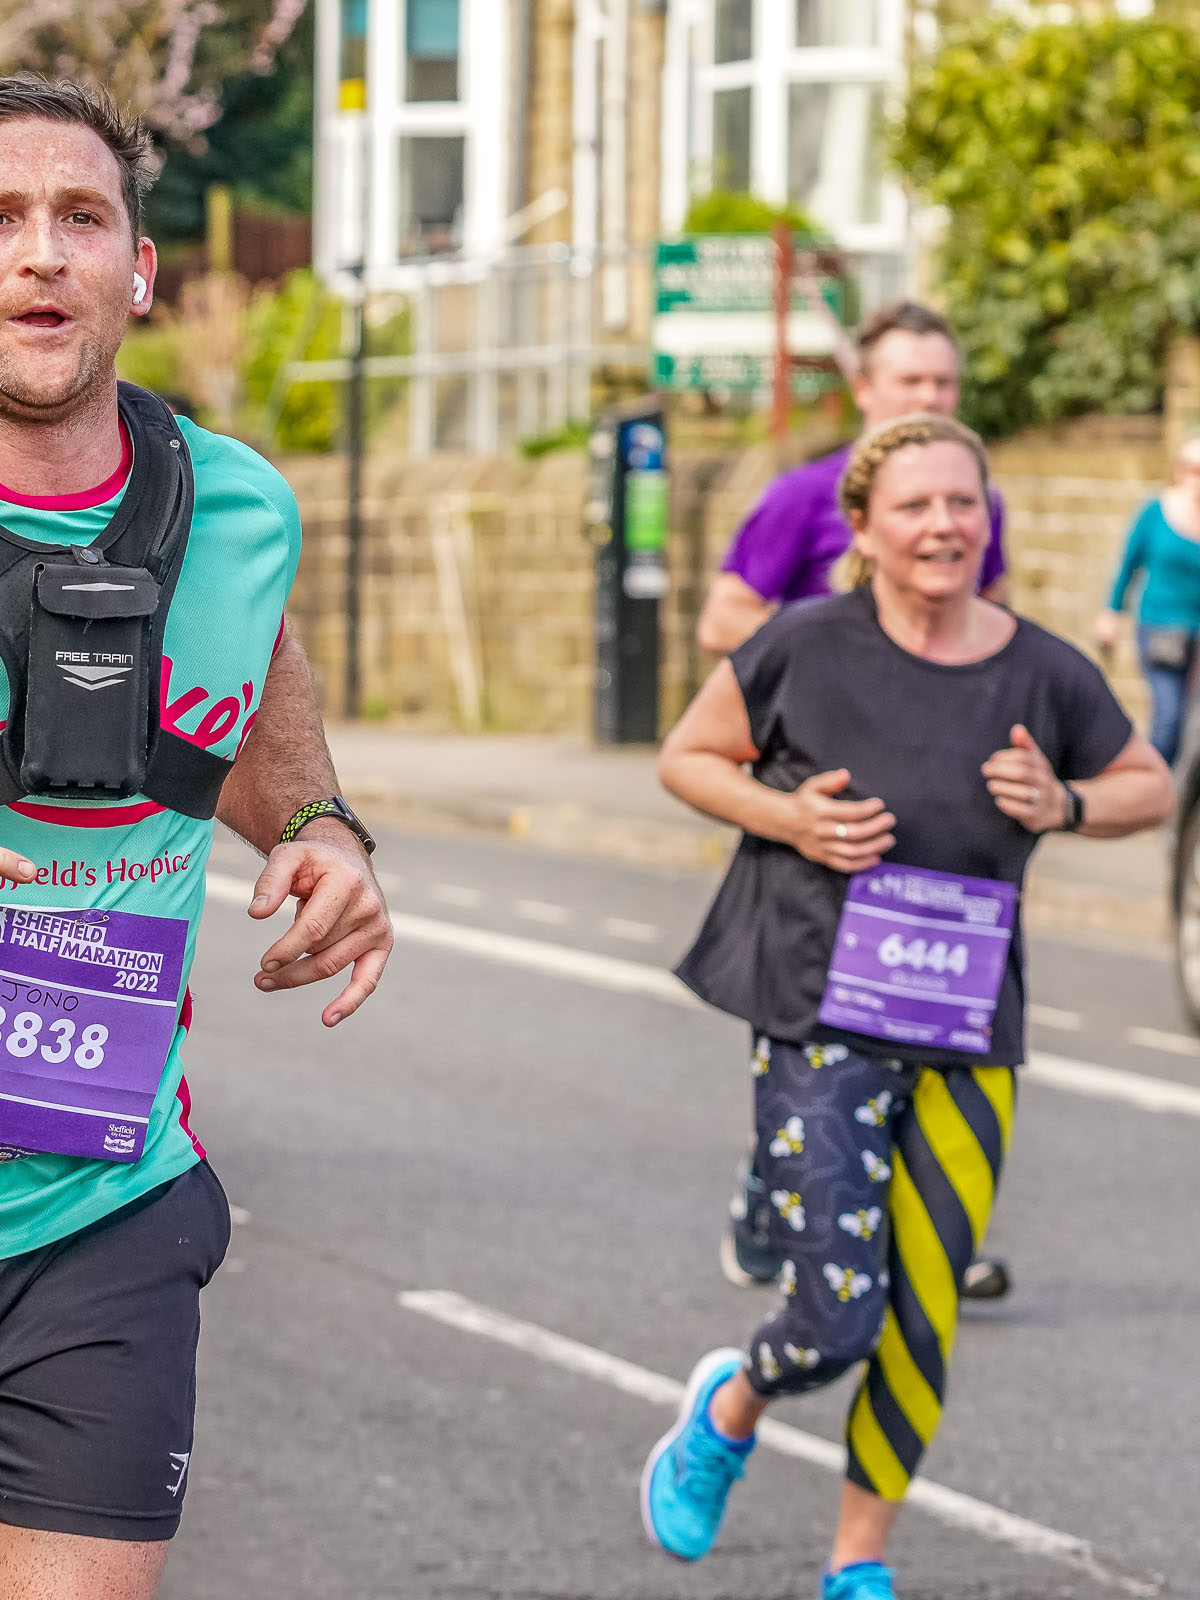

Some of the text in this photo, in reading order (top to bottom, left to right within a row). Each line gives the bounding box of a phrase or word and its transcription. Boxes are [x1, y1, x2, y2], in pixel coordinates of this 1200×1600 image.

[55, 650, 134, 664] FREE TRAIN
[13, 909, 104, 944] SHEFFIELD
[9, 928, 163, 973] HALF MARATHON
[876, 932, 970, 978] 6444
[1, 978, 80, 1012] JONO
[112, 970, 160, 993] 2022
[108, 1123, 136, 1135] Sheffield
